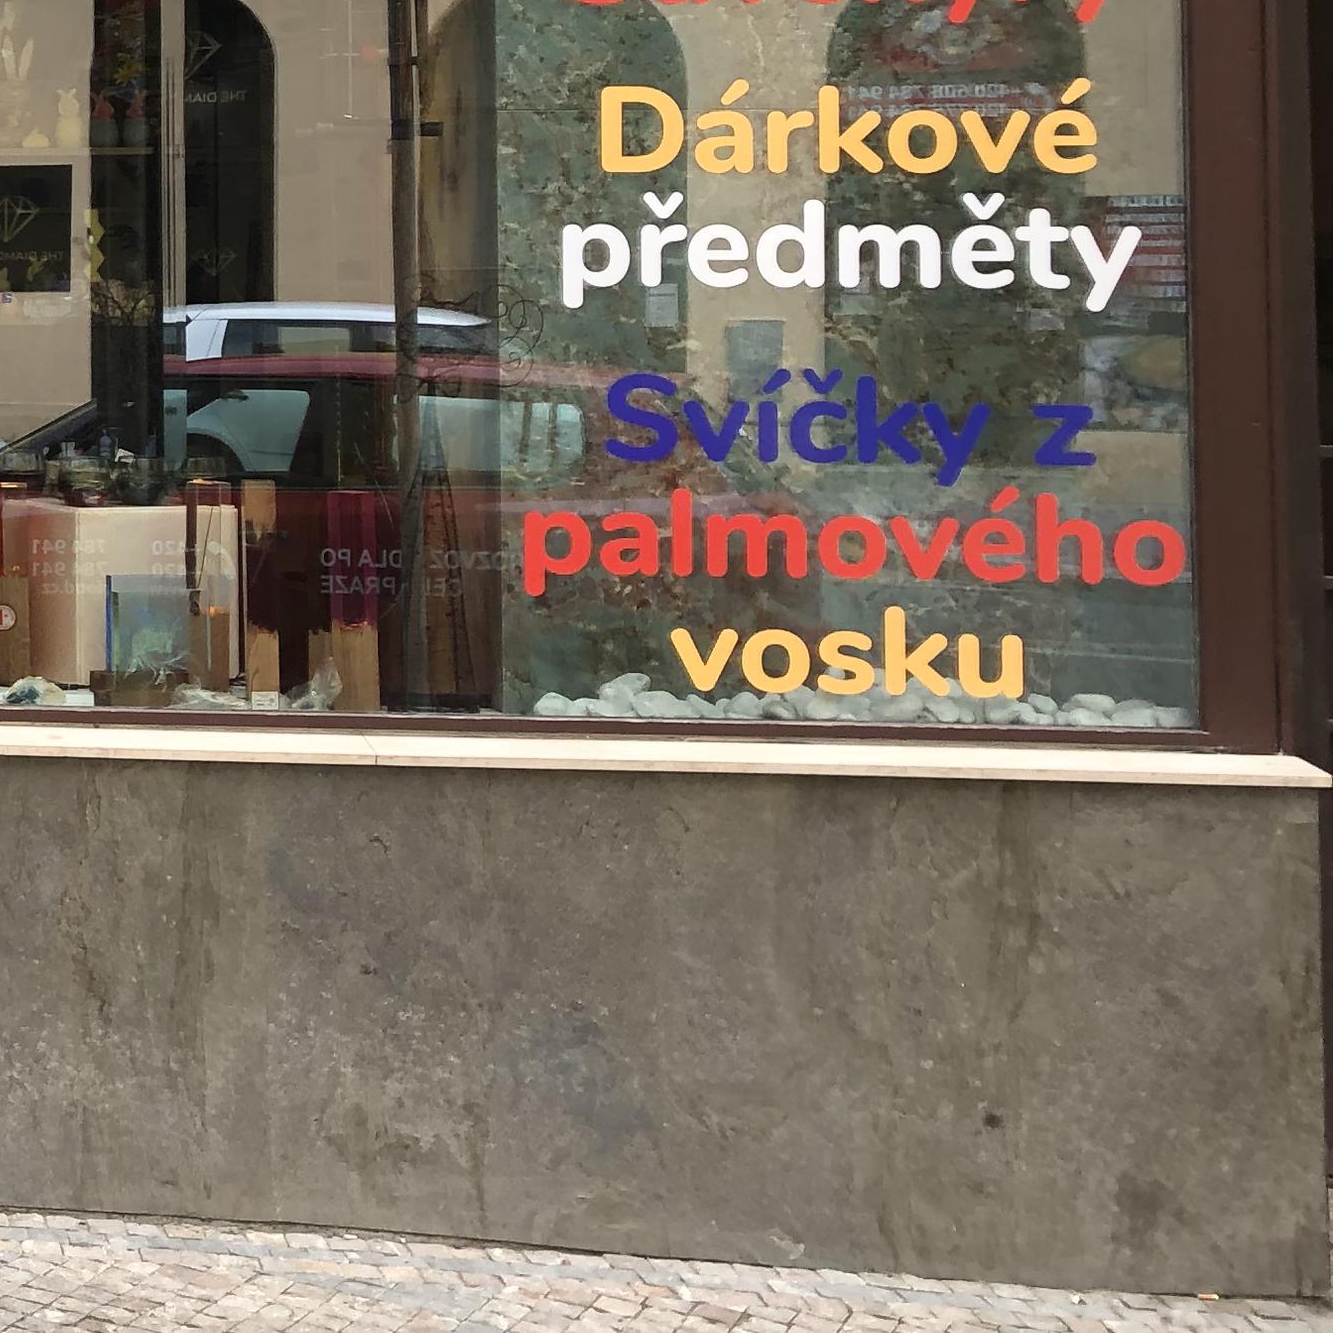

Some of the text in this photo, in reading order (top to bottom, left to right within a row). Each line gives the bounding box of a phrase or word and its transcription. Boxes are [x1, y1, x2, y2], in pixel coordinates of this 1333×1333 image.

[599, 76, 1099, 175] Dárkové
[561, 190, 1143, 313] předměty
[604, 367, 1098, 487] Svíčky z
[520, 485, 1187, 598] palmového
[668, 605, 1025, 700] vosku
